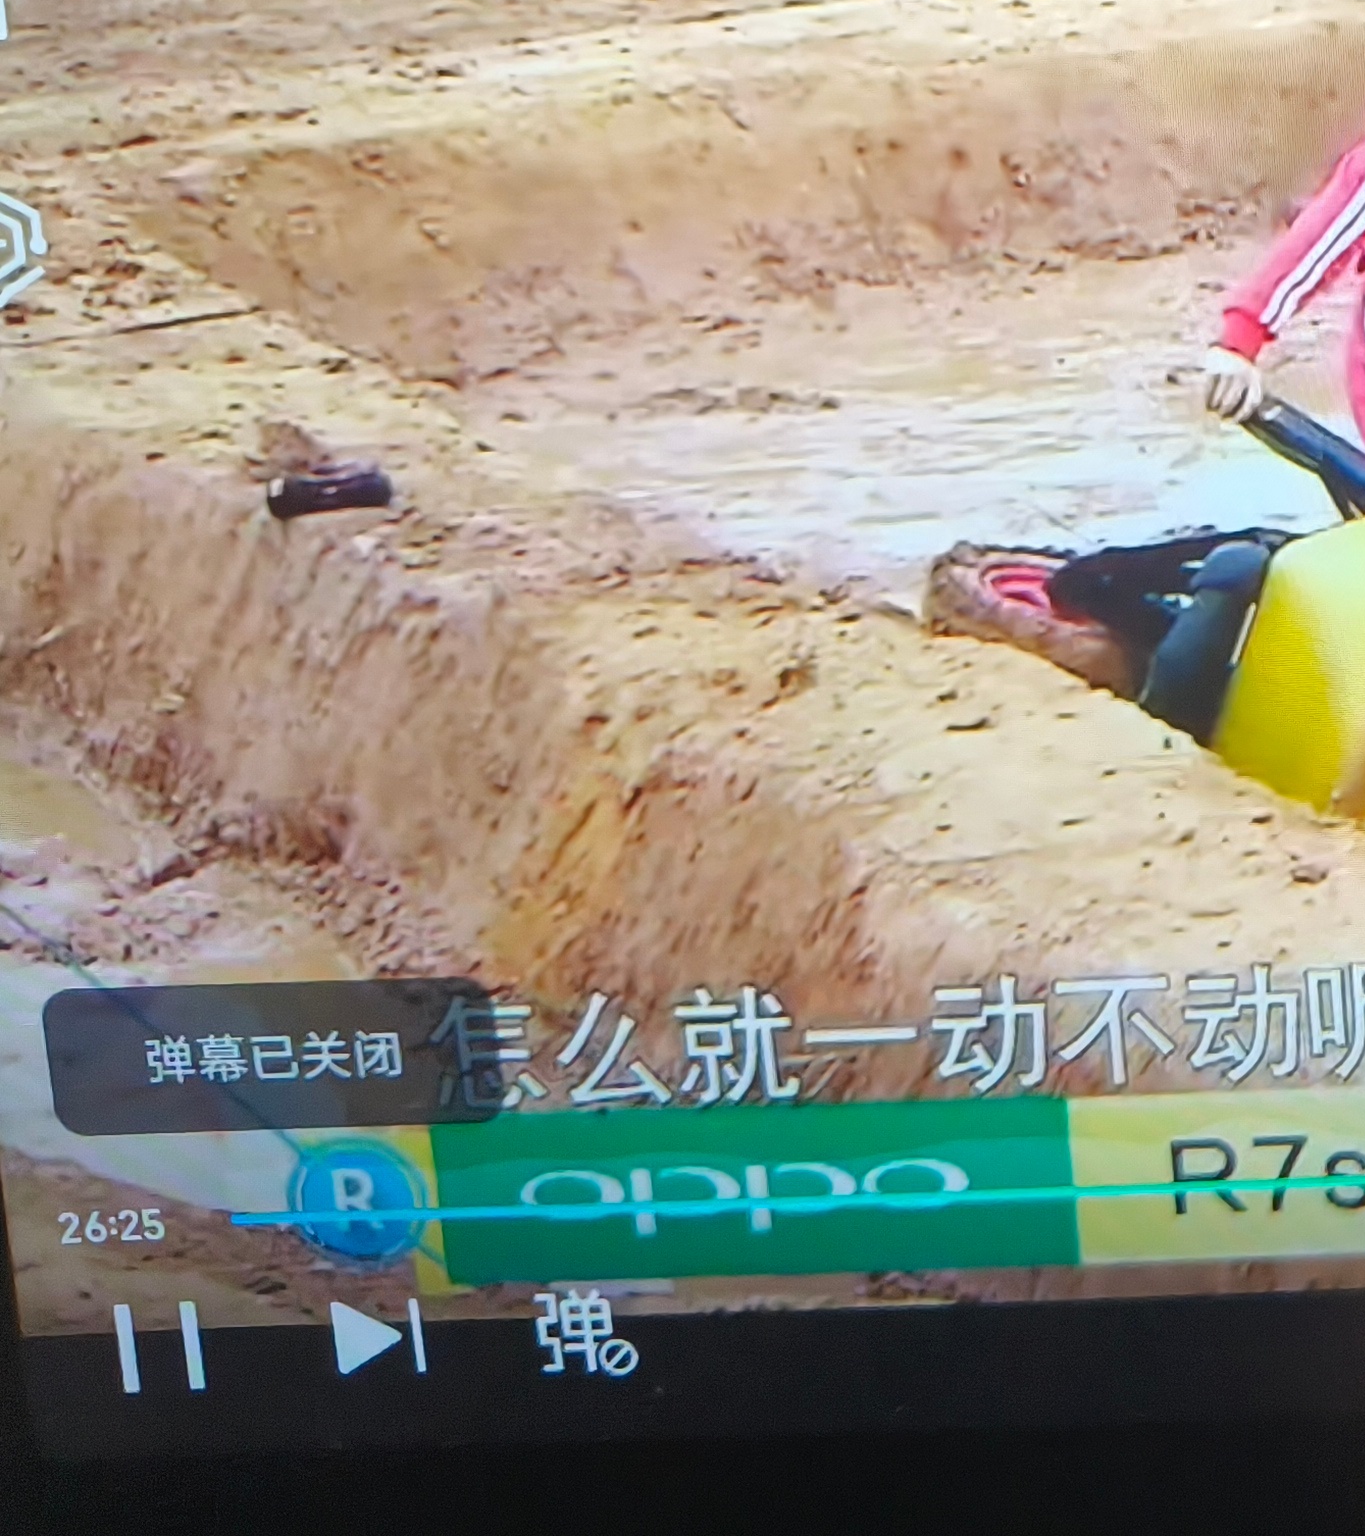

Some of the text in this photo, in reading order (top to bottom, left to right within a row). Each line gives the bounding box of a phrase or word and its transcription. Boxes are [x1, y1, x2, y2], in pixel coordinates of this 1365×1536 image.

[145, 1029, 402, 1085] 弹幕已关闭
[58, 1208, 166, 1246] 26:25
